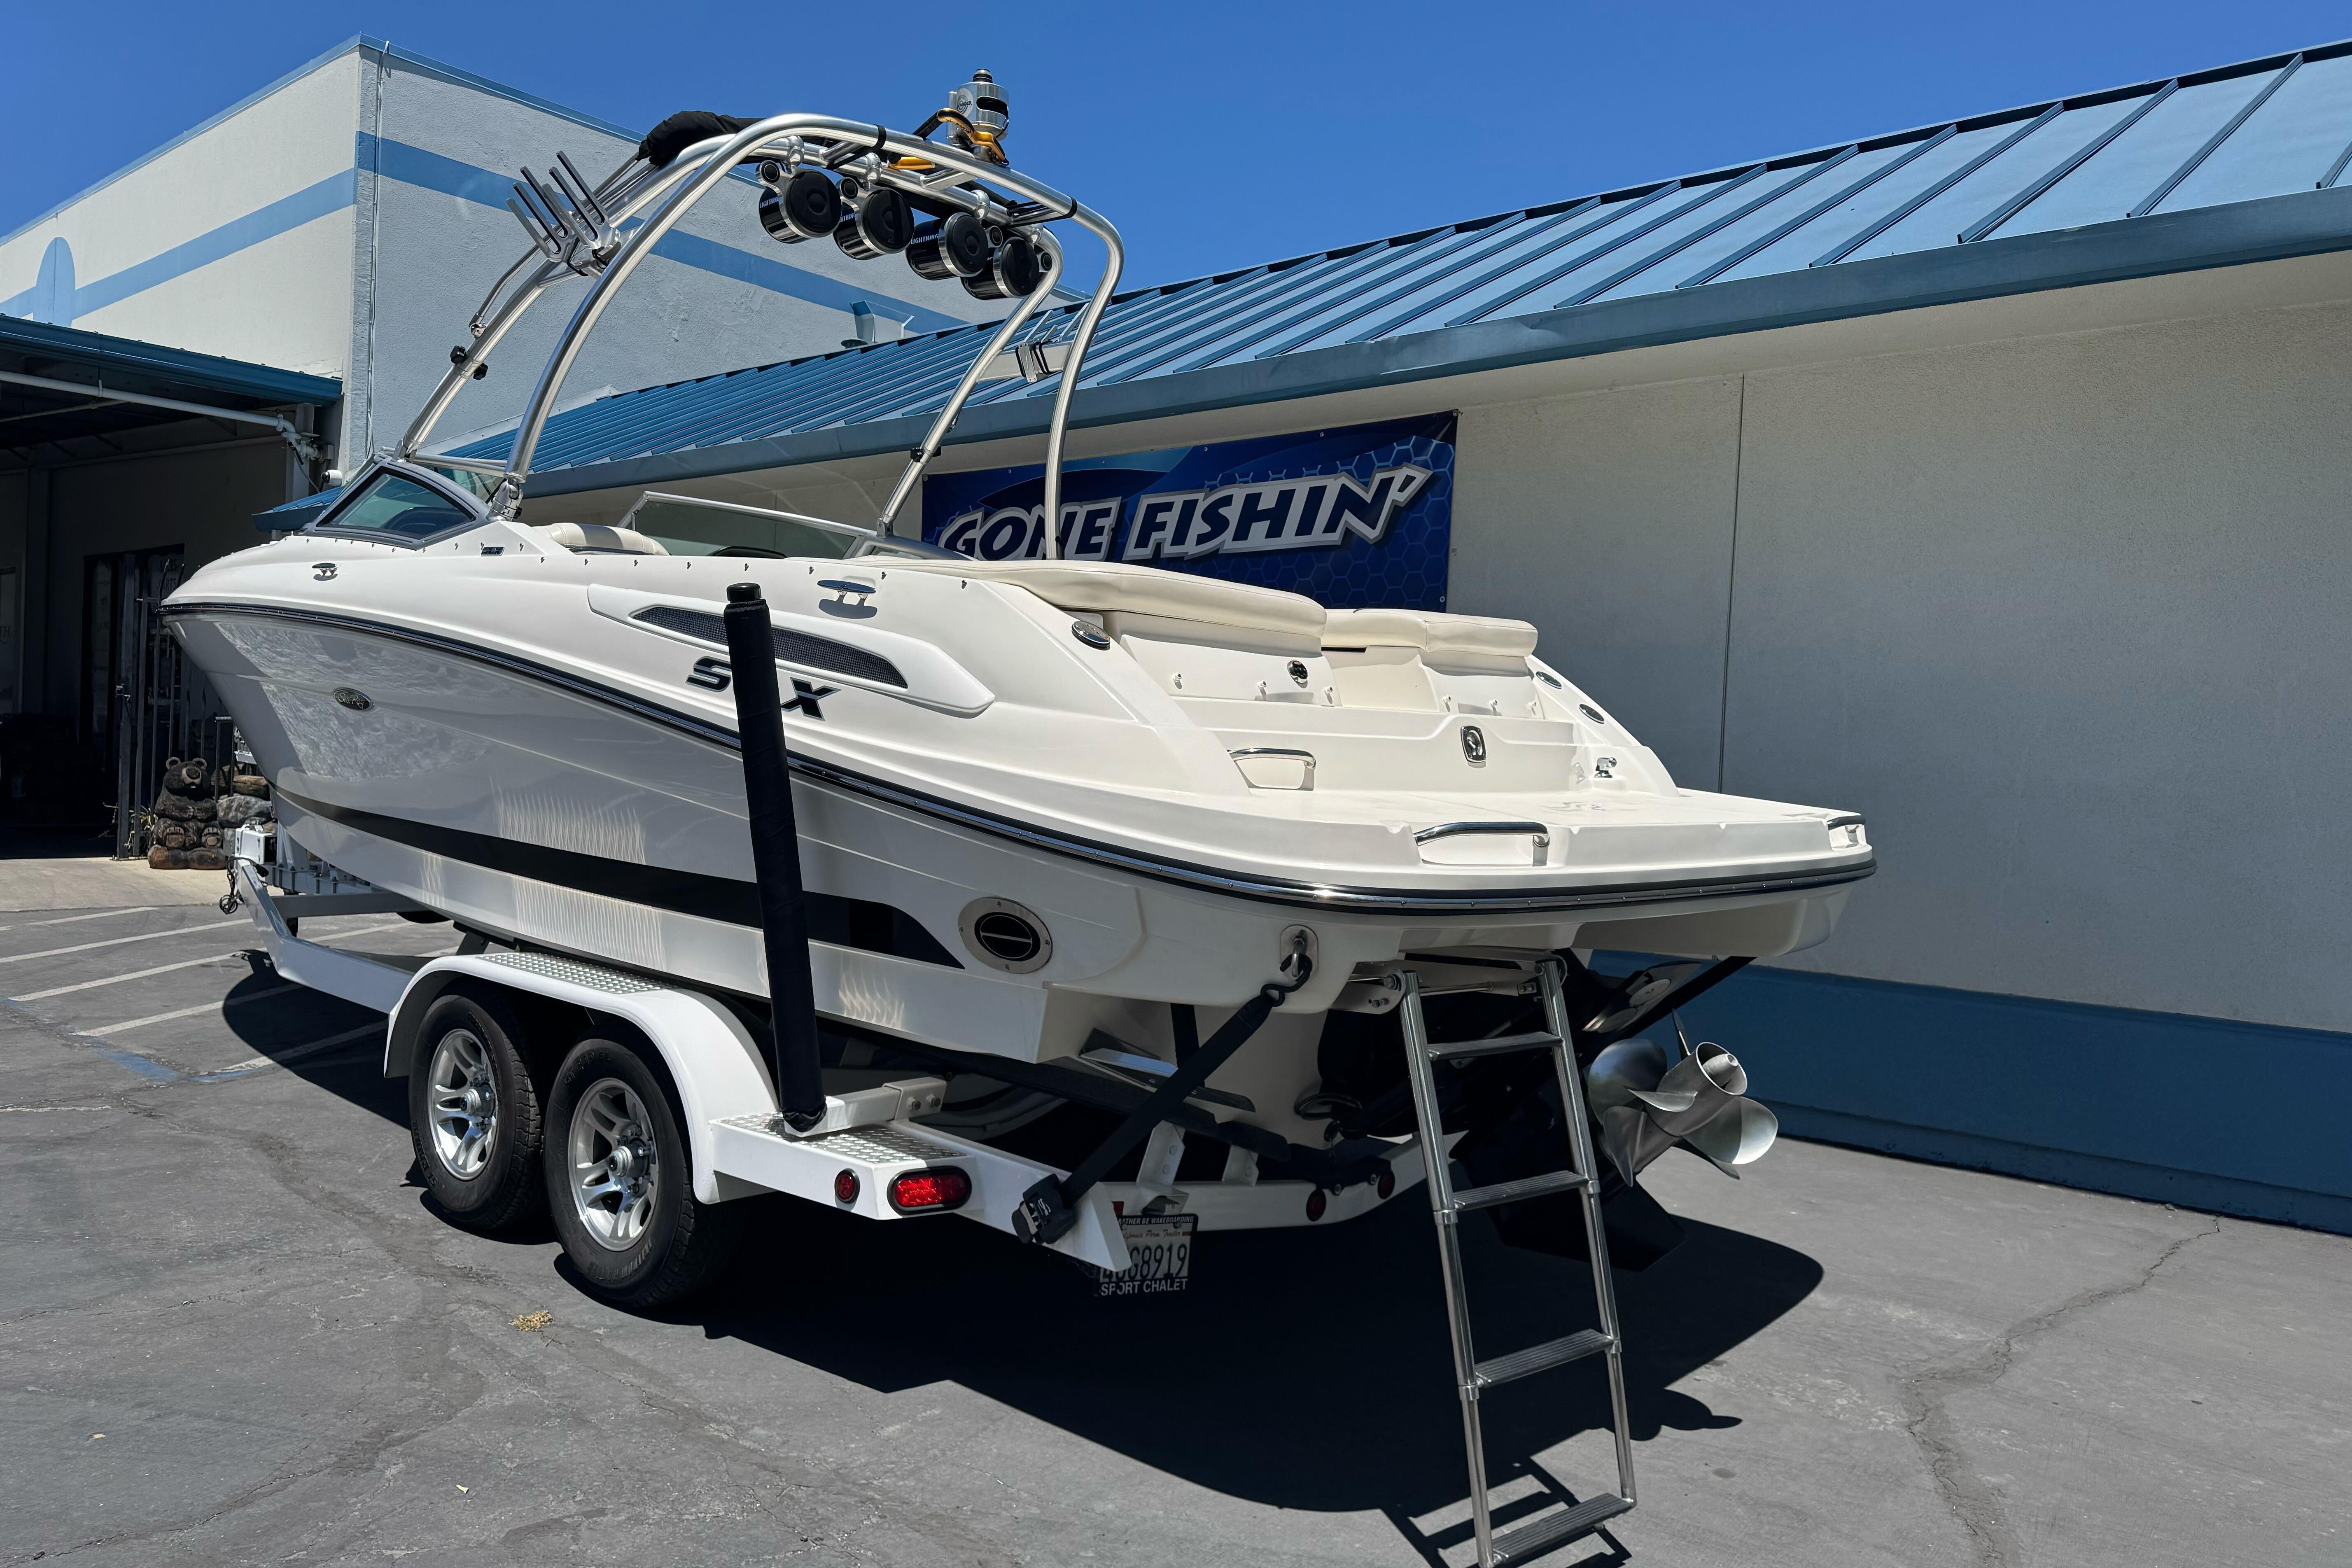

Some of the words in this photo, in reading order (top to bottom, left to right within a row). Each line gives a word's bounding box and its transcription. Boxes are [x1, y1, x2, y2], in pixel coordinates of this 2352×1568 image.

[940, 498, 1120, 561] GONE
[1129, 466, 1430, 558] FISHIN'
[685, 656, 840, 721] SX
[1151, 1216, 1194, 1224] WAKEBOARDING
[1123, 1230, 1143, 1241] lifornia
[1103, 1244, 1187, 1282] G8919
[1143, 1278, 1188, 1293] CHALET
